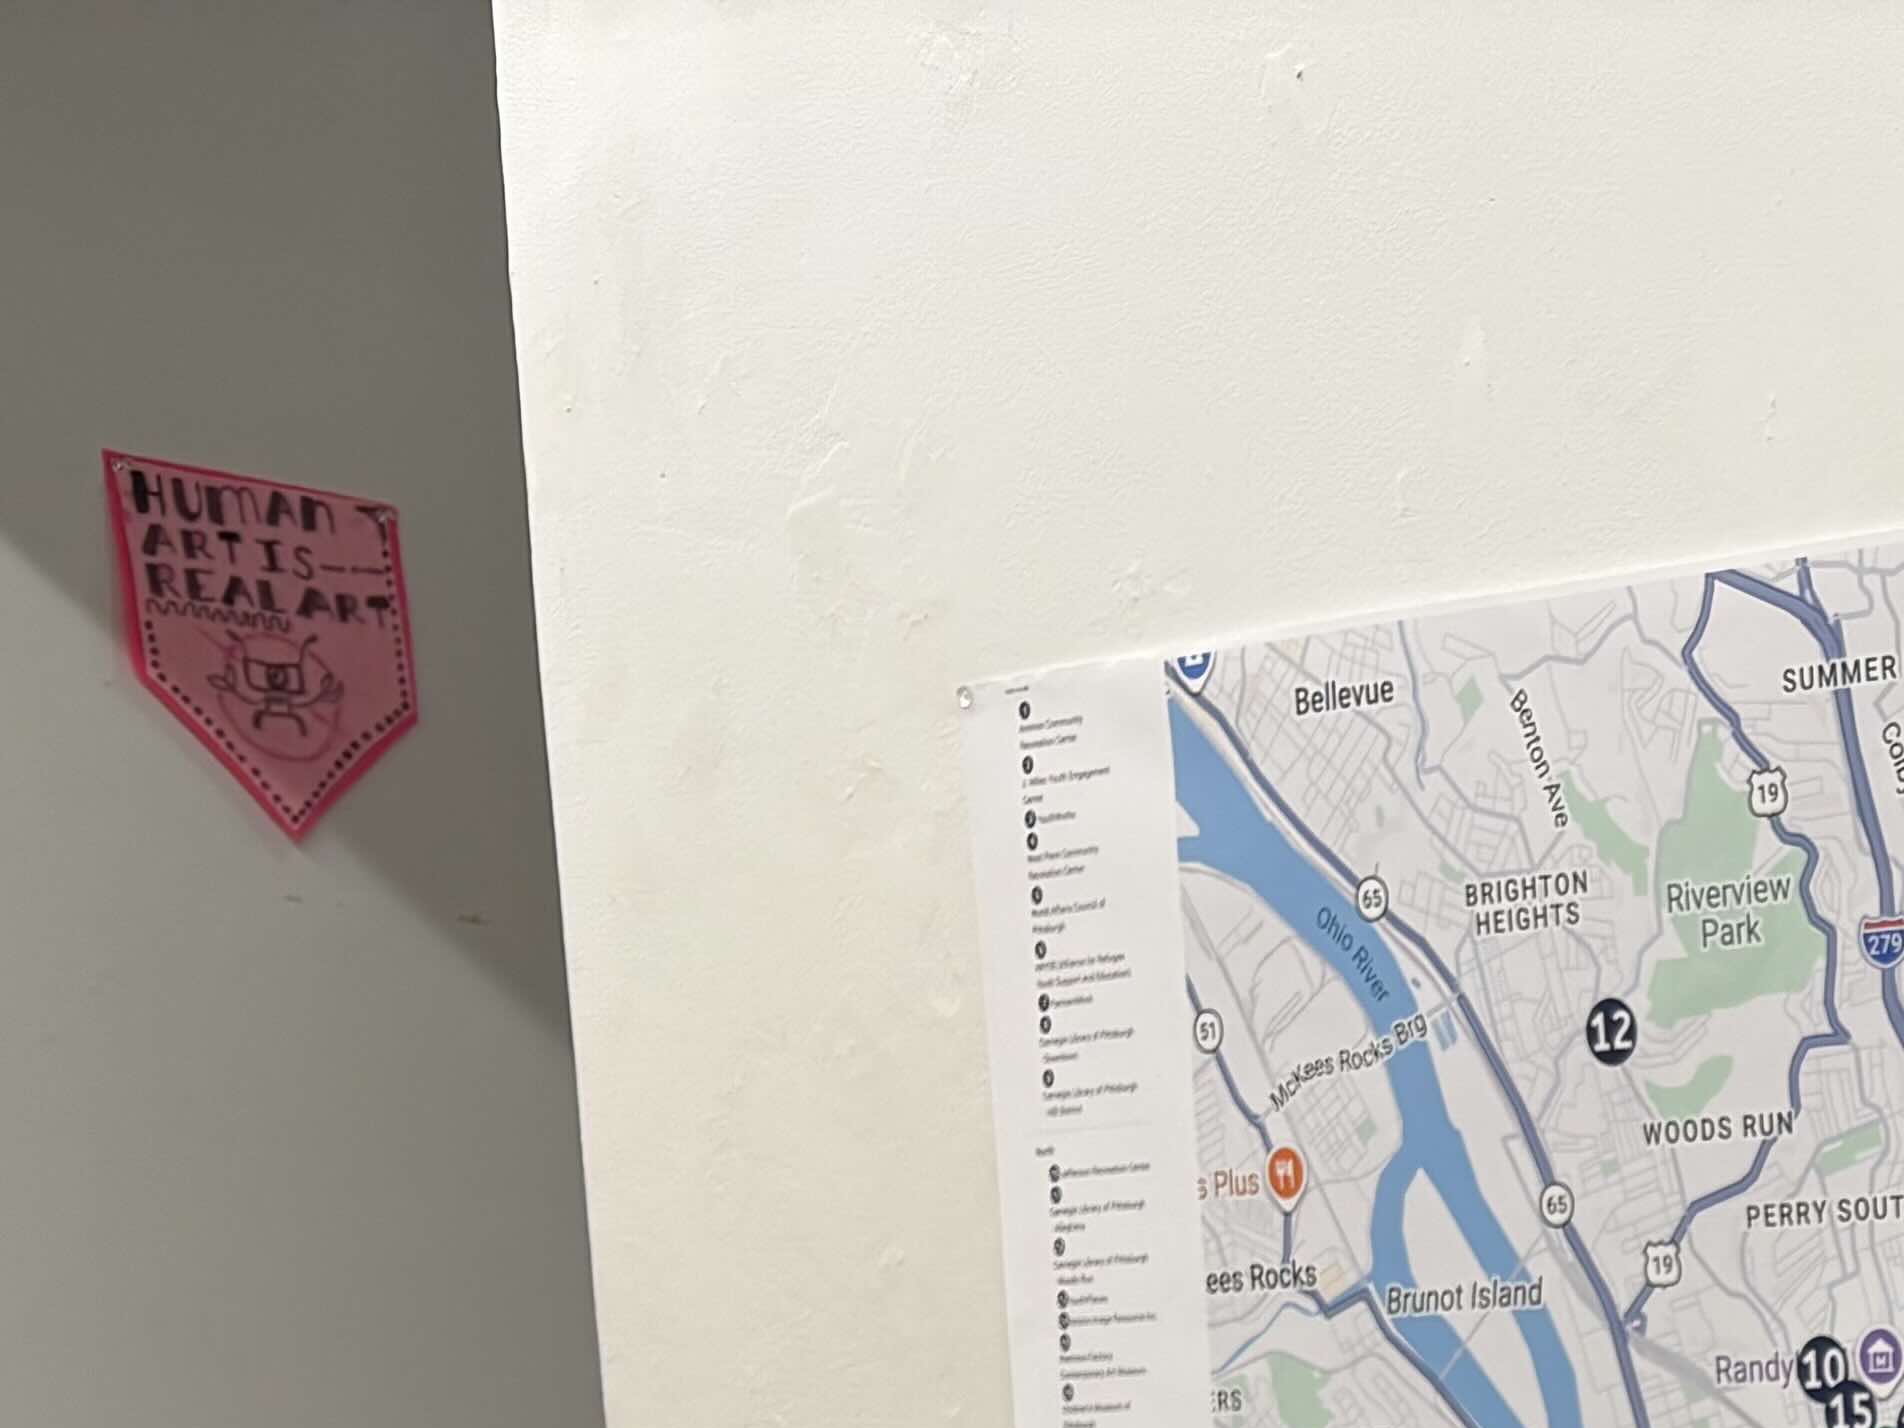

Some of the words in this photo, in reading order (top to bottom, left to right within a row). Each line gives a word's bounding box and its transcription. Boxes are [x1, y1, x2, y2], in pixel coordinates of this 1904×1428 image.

[143, 524, 241, 564] ART
[255, 539, 314, 580] IS
[145, 563, 286, 616] REAL
[297, 587, 394, 628] ART
[1782, 655, 1897, 693] SUMMER
[1295, 677, 1394, 716] Bellevue
[1465, 870, 1588, 908] BRIGHTON
[1667, 875, 1791, 914] Riverview
[1476, 902, 1580, 935] HEIGHTS
[1701, 915, 1762, 948] Park
[1868, 934, 1903, 958] 279
[1590, 1008, 1632, 1047] 12
[1644, 1116, 1733, 1146] WOODS
[1742, 1111, 1795, 1138] RUN
[1747, 1199, 1829, 1229] PERRY
[1386, 1281, 1464, 1317] Brunot
[1472, 1277, 1544, 1310] Island
